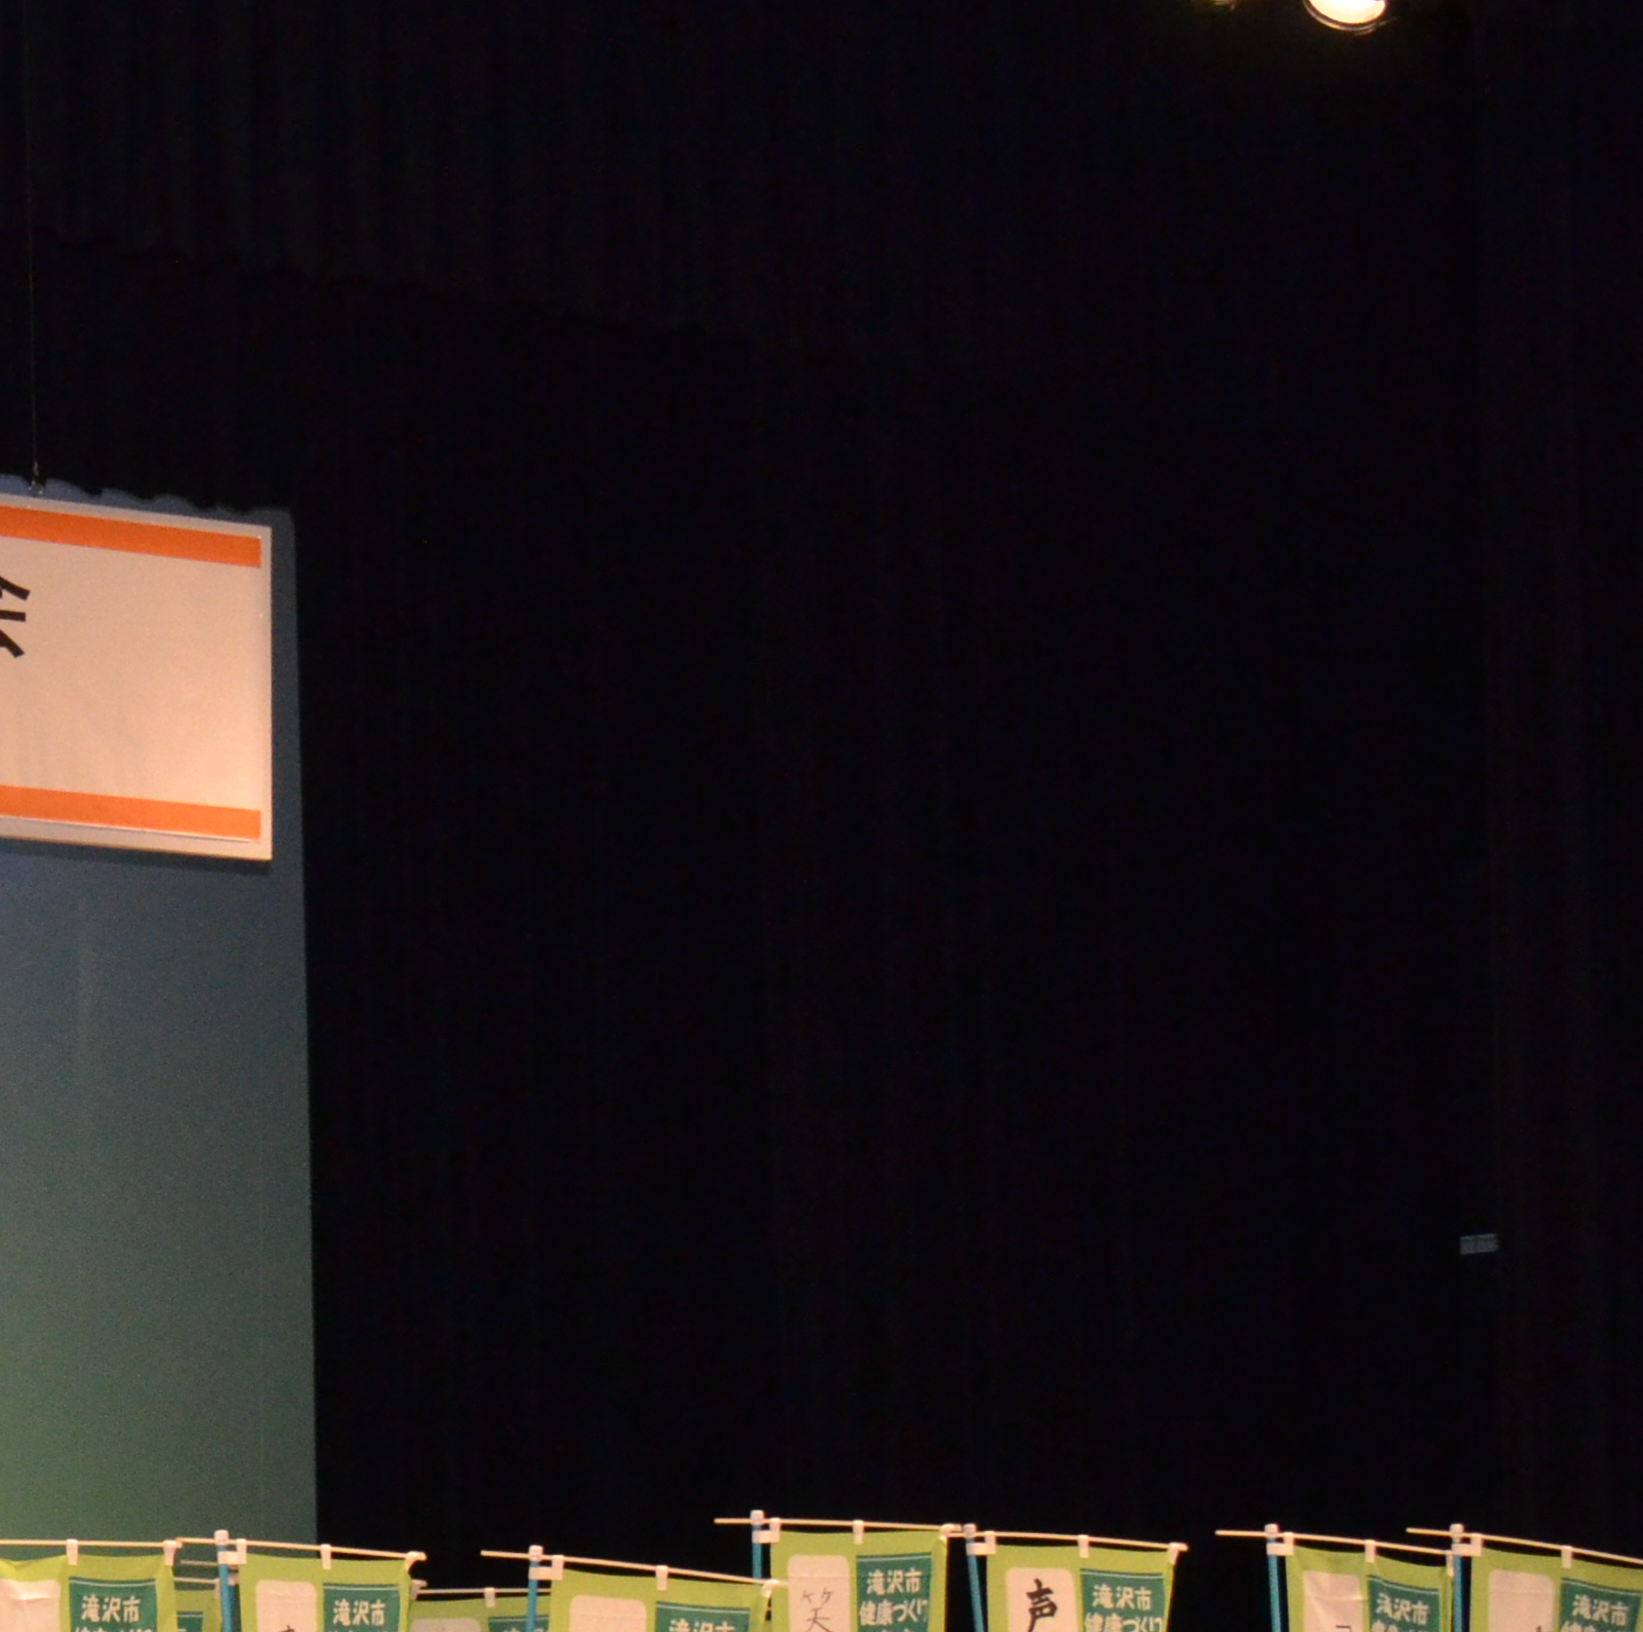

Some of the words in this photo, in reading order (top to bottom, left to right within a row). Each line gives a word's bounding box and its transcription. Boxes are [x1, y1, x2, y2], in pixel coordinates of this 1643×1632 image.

[867, 1568, 921, 1594] 滝沢市
[82, 1596, 141, 1622] 滝沢市
[1093, 1584, 1152, 1611] 滝沢市
[333, 1600, 385, 1626] 滝沢市
[859, 1600, 927, 1626] 健康づくり
